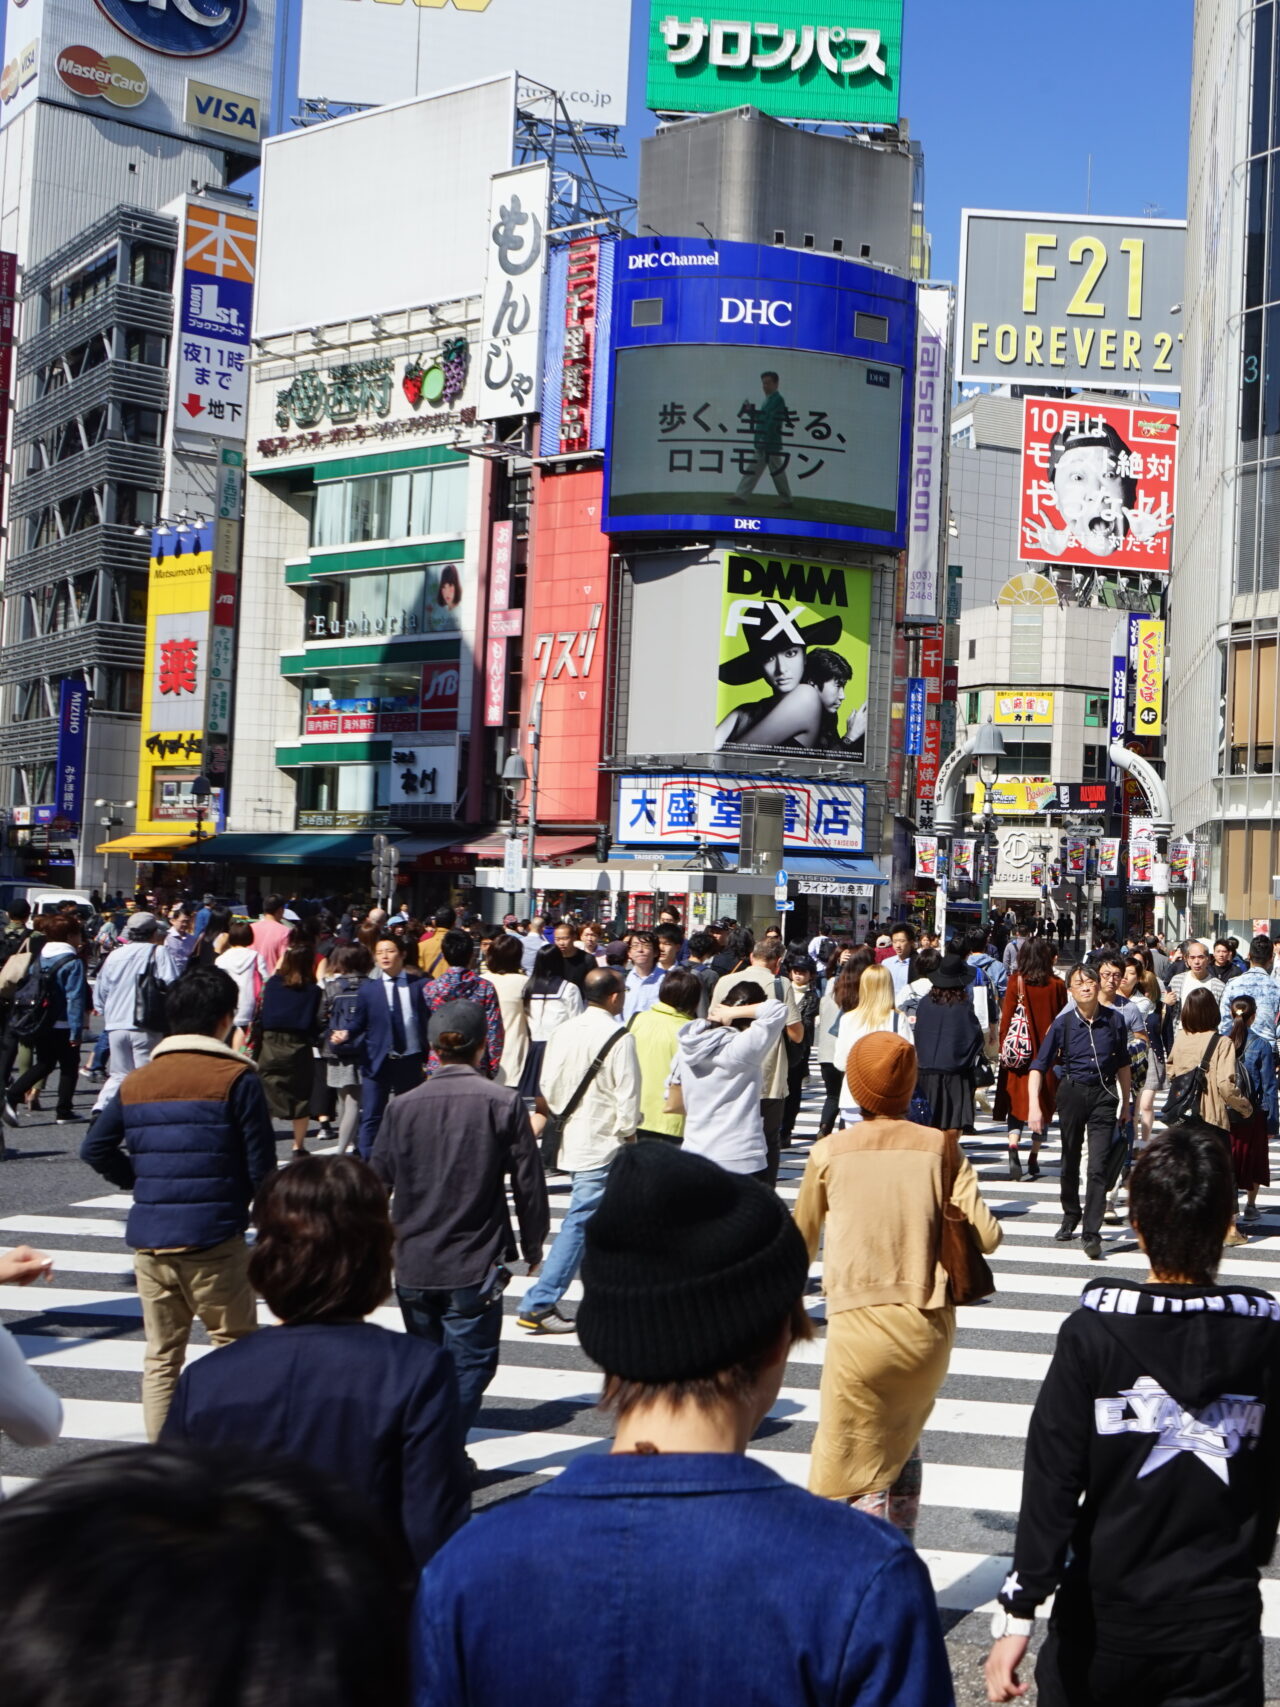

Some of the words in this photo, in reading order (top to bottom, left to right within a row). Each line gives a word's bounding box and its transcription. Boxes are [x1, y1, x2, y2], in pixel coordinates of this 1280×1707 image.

[660, 16, 886, 76] サロンパス
[58, 57, 146, 93] MasterCard
[195, 94, 257, 129] VISA
[628, 252, 658, 269] DHC
[660, 252, 719, 267] Channel
[1023, 233, 1144, 318] F21
[485, 194, 542, 408] もんじゃ
[720, 297, 792, 327] DHC
[183, 341, 244, 372] 夜11時
[971, 322, 1142, 370] FOREVER
[194, 367, 232, 391] まで
[868, 372, 888, 383] DHC
[207, 398, 243, 423] 地下
[658, 401, 846, 443] 歩く、生きる、
[1030, 407, 1108, 438] 10月は
[1026, 442, 1172, 482] モト絶対
[912, 444, 932, 533] neon
[734, 518, 761, 530] DHC
[727, 555, 849, 608] DMM
[910, 581, 933, 591] 3719
[911, 570, 932, 581] (03)
[909, 591, 933, 600] 2468
[724, 599, 806, 646] FX
[159, 637, 198, 696] 薬
[425, 670, 460, 701] JTB
[69, 691, 82, 734] MIZUHO
[1140, 709, 1157, 722] 4F
[798, 882, 873, 896] ライオン12発売!!
